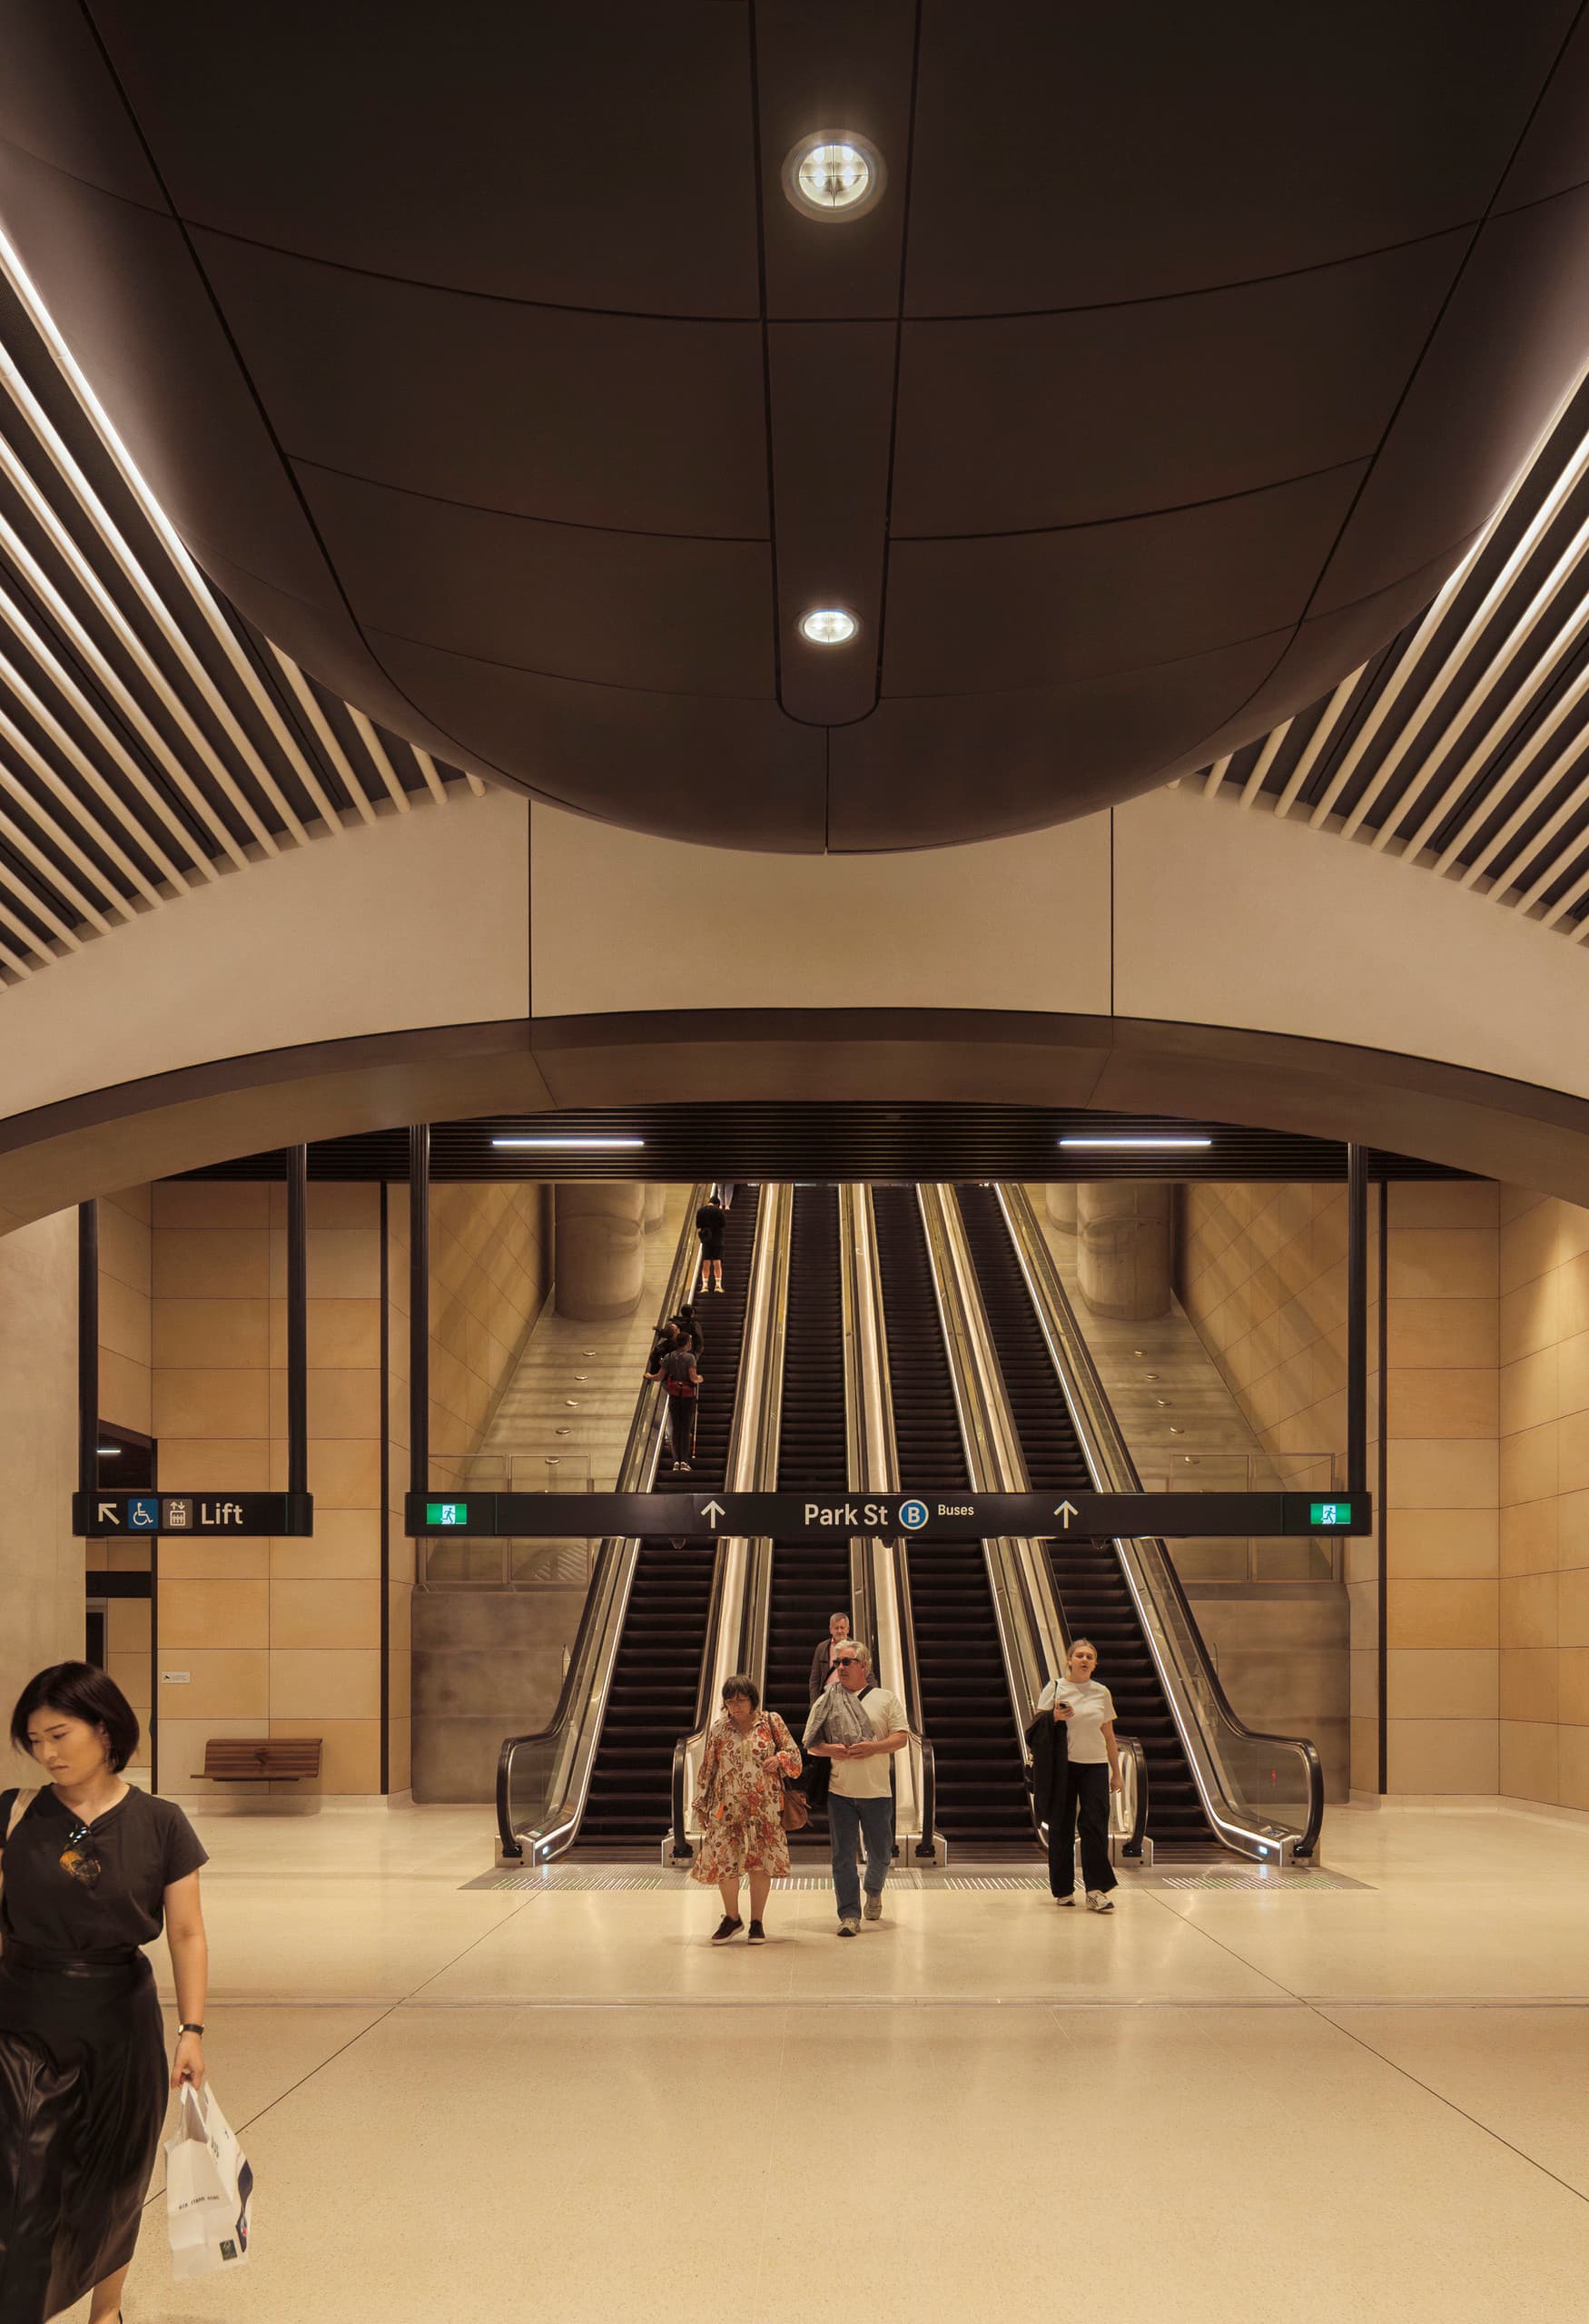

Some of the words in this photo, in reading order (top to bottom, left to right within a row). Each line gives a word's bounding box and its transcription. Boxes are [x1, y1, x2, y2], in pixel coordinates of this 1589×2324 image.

[202, 1502, 243, 1525] Lift
[804, 1503, 859, 1526] Park
[864, 1503, 889, 1526] St
[908, 1506, 921, 1523] B
[938, 1503, 974, 1516] Buses
